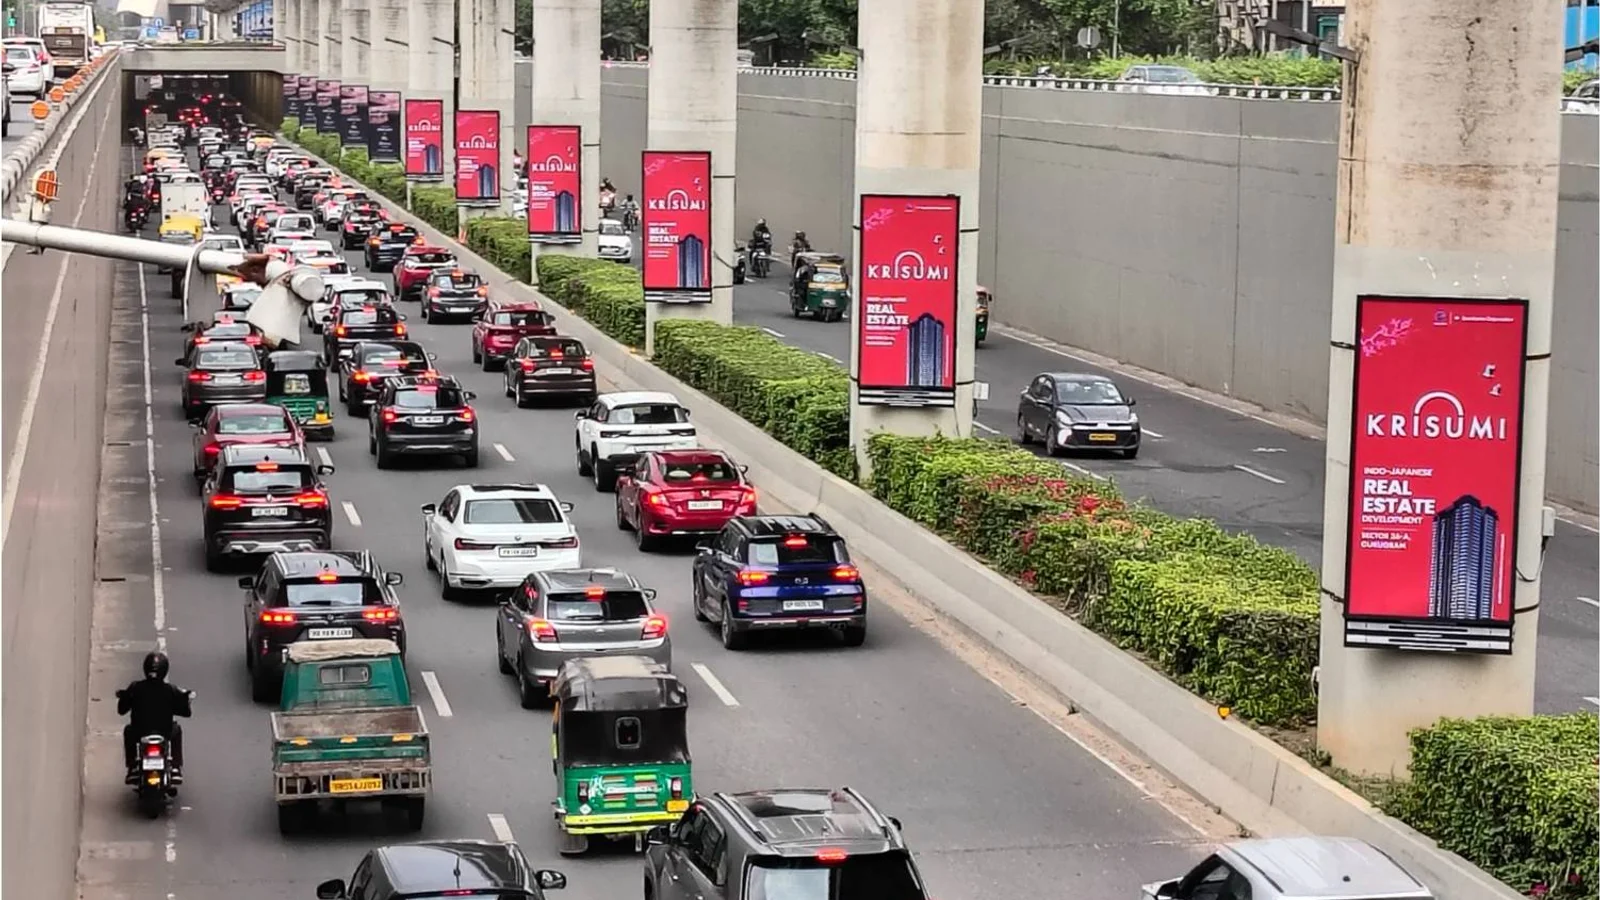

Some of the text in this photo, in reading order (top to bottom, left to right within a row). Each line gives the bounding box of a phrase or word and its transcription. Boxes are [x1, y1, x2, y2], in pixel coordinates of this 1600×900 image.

[648, 199, 705, 210] KRISUMI
[867, 264, 949, 280] KRISUMI
[866, 303, 896, 314] REAL
[866, 315, 909, 325] ESTATE
[1366, 413, 1507, 440] KRISUMI
[1363, 479, 1413, 496] REAL
[1362, 497, 1436, 515] ESTATE
[1361, 515, 1423, 525] DEVELOPMENT
